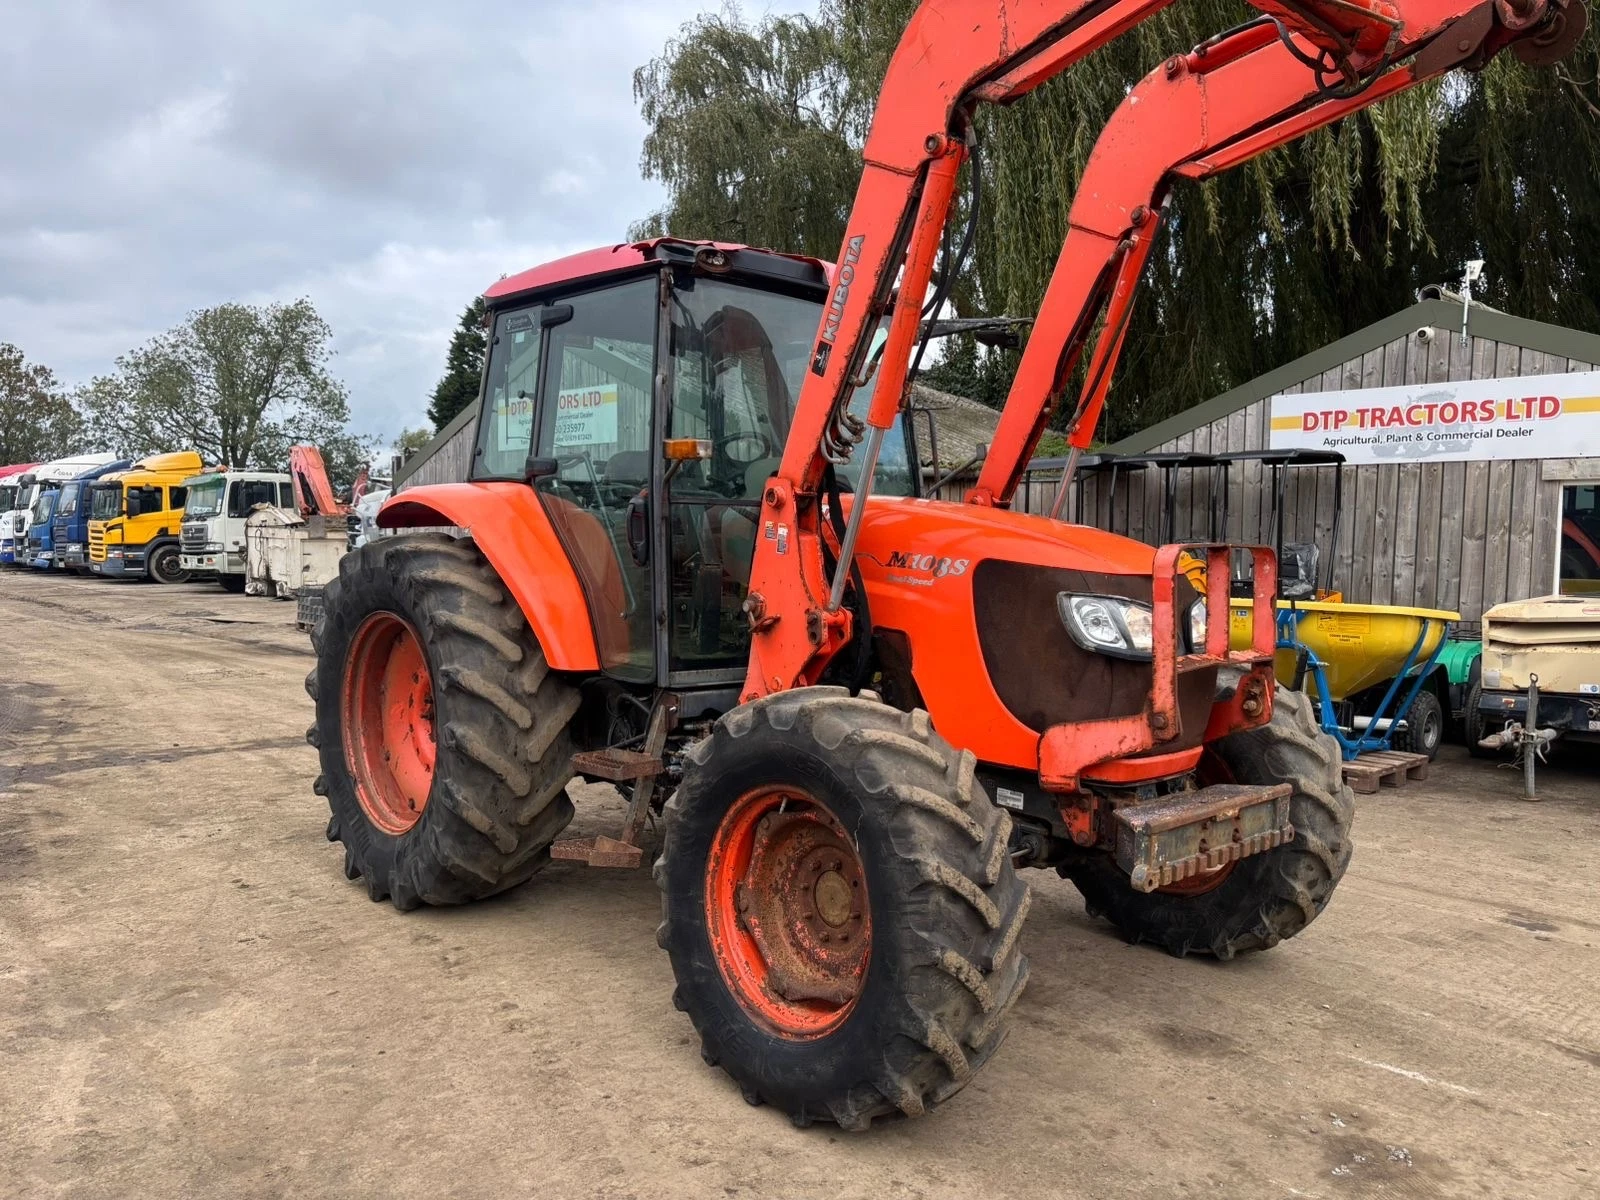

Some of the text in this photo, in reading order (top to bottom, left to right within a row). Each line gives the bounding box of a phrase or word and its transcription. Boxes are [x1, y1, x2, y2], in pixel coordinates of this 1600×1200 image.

[822, 234, 865, 342] KUBOTA
[511, 400, 528, 415] DTP
[583, 391, 601, 407] LTD
[1302, 395, 1561, 431] DTP TRACTORS LTD
[1322, 427, 1534, 447] Agricultural, Plant & Commercial Dealer
[908, 576, 934, 586] Speed
